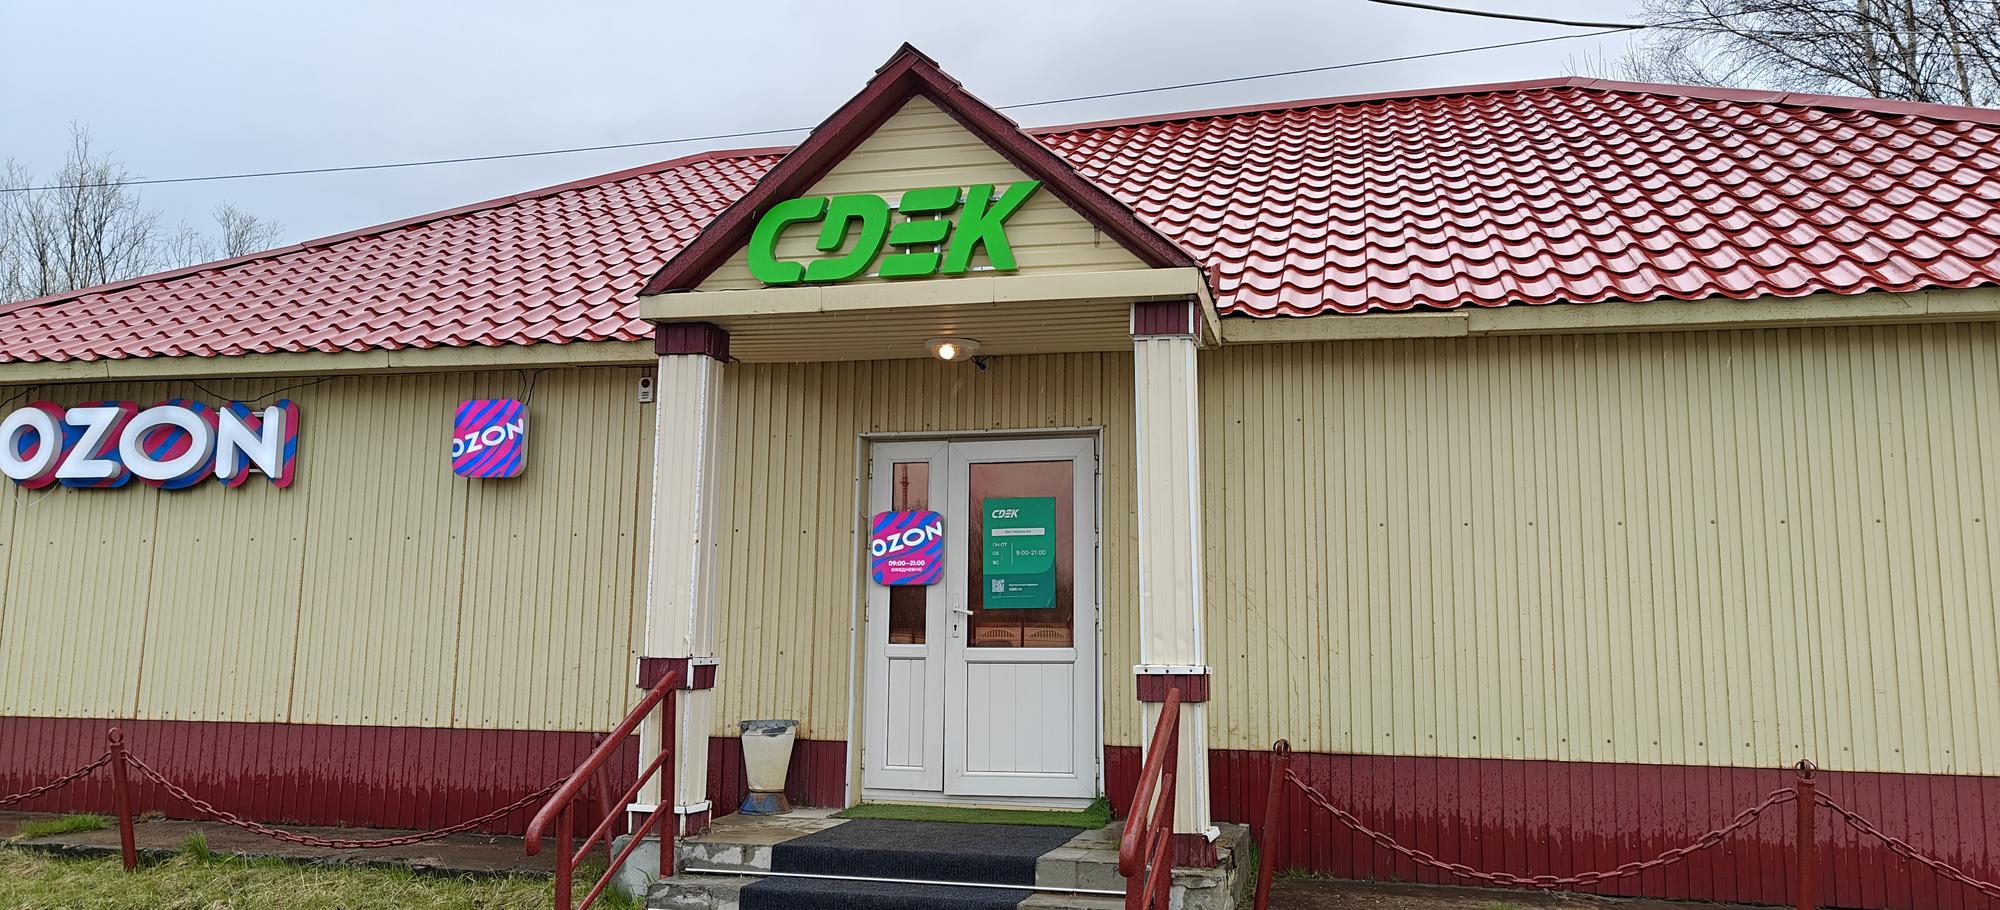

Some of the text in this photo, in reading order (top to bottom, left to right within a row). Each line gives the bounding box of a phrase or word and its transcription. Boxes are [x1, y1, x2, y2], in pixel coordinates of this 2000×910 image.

[747, 180, 1042, 284] CDEK
[0, 405, 286, 480] OZON
[452, 418, 524, 458] OZON
[991, 508, 1020, 519] CDEK
[872, 521, 942, 557] OZON
